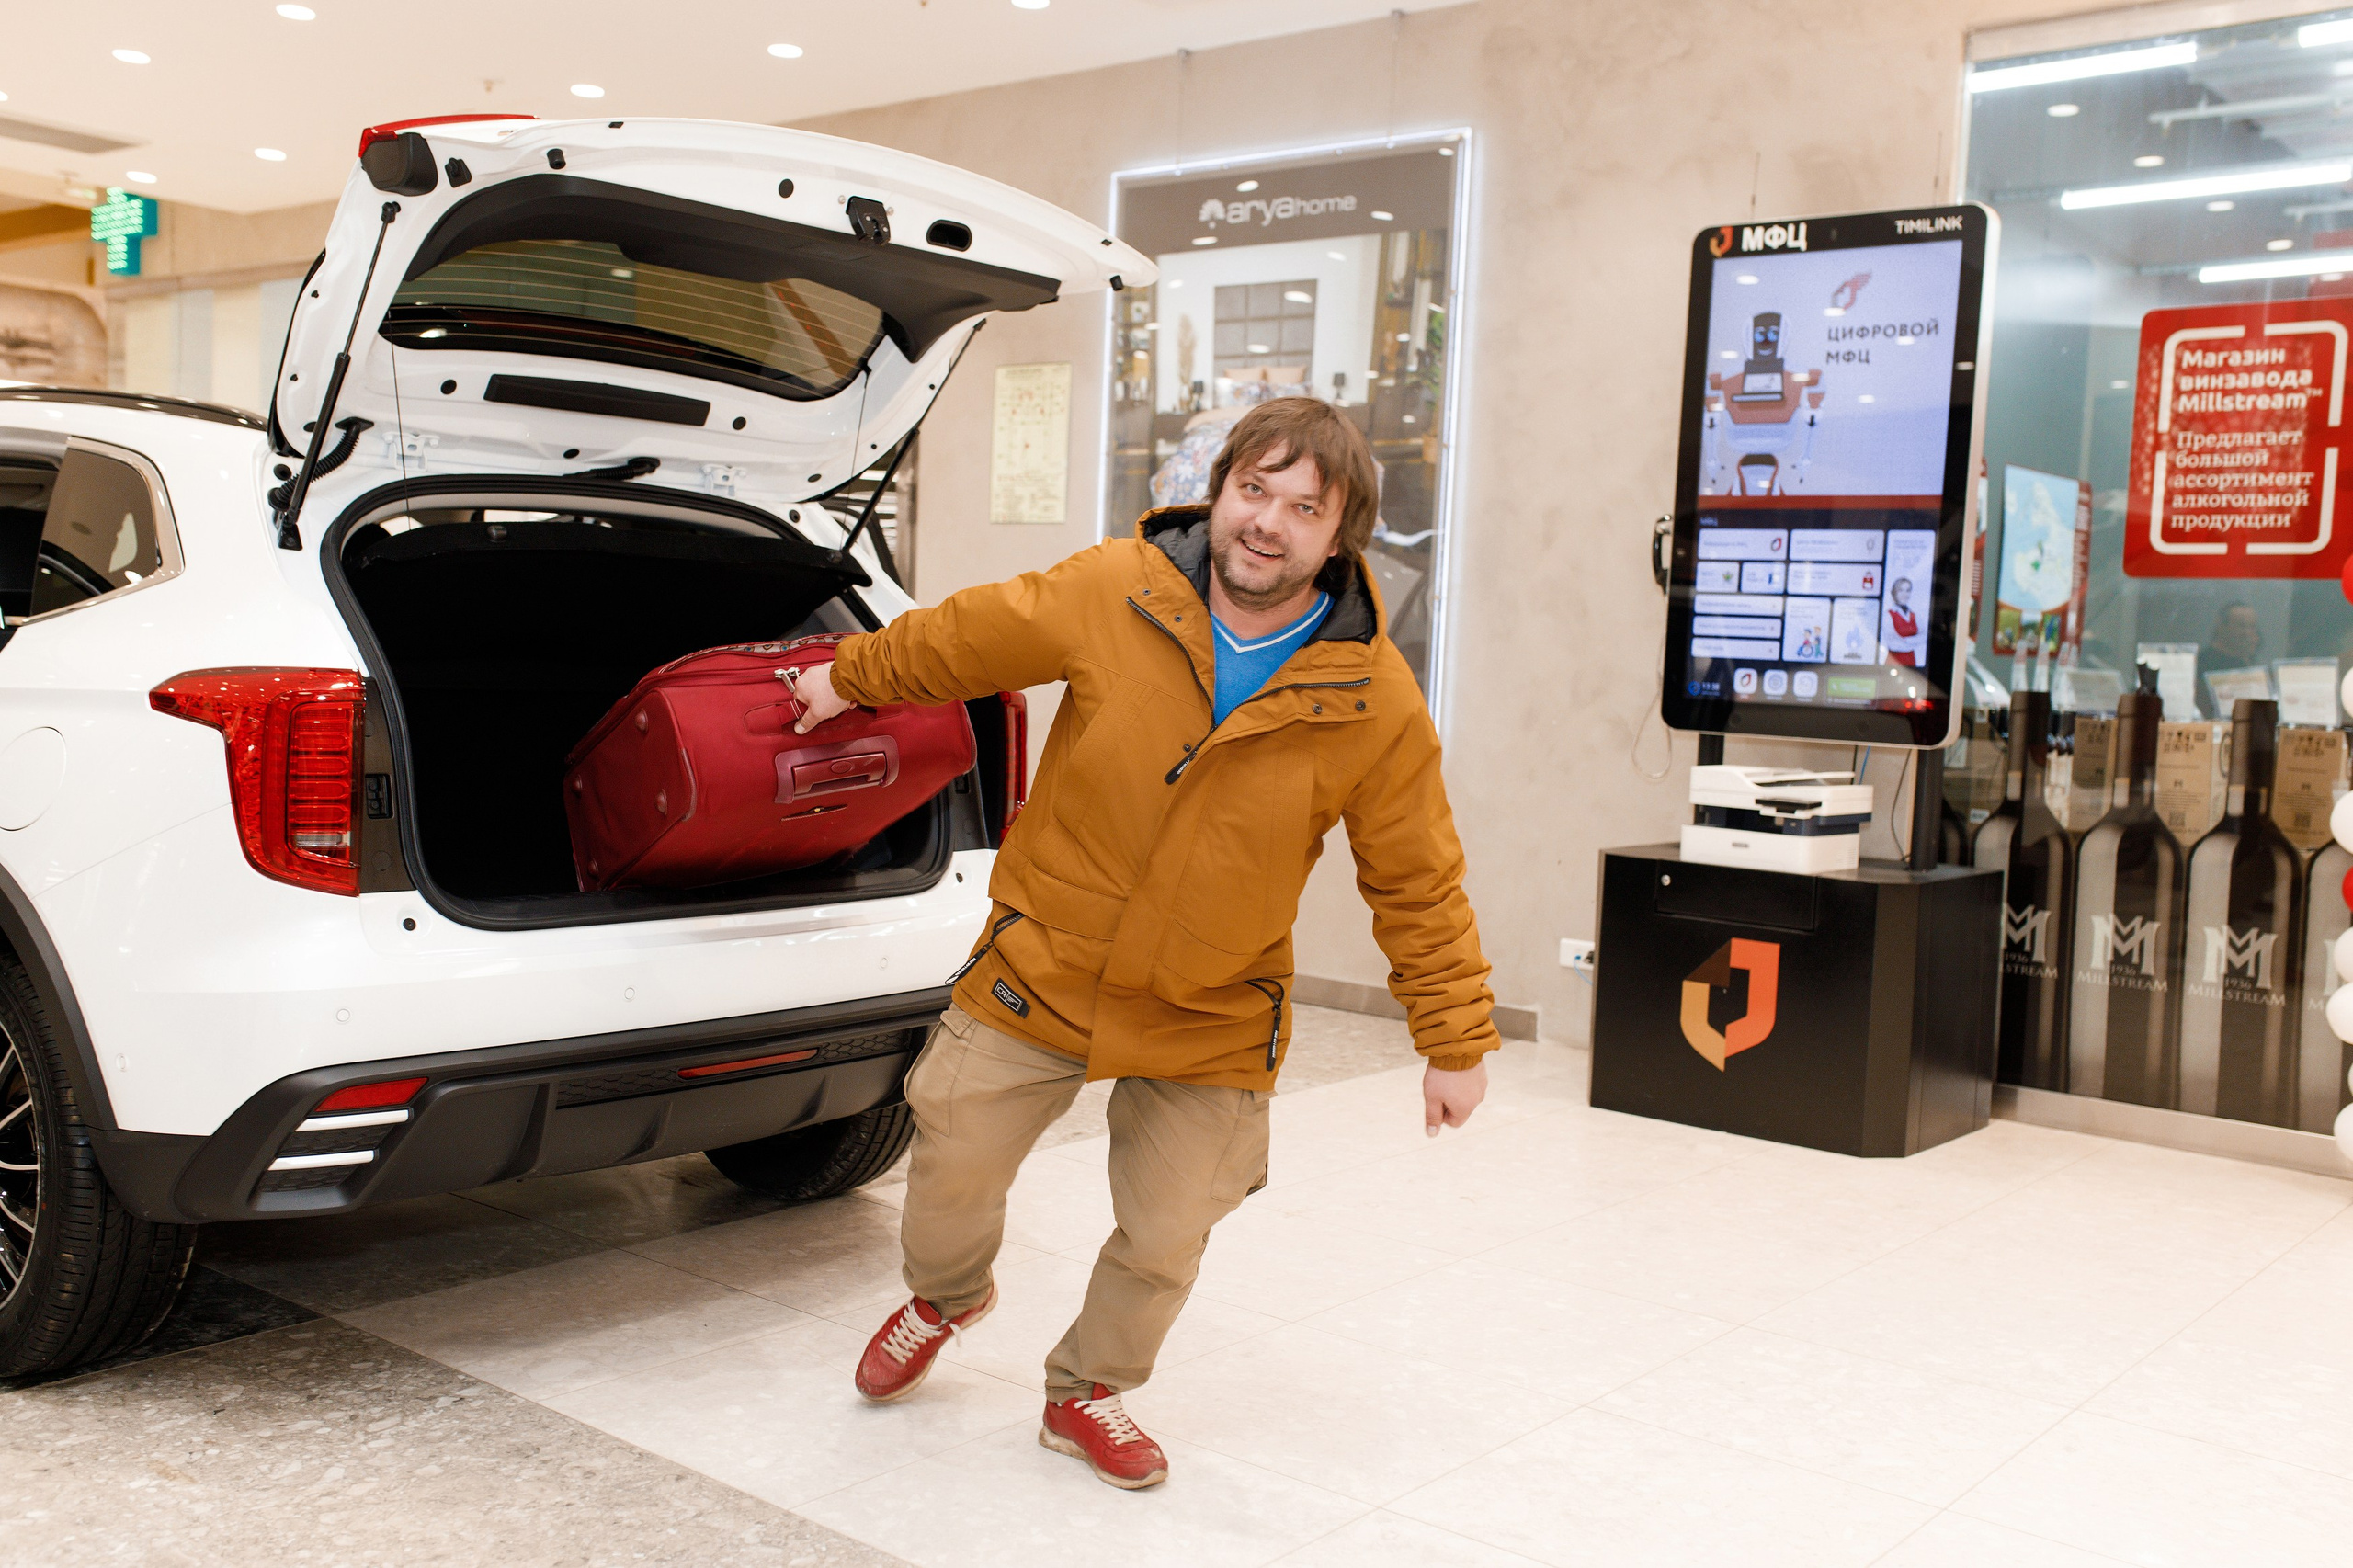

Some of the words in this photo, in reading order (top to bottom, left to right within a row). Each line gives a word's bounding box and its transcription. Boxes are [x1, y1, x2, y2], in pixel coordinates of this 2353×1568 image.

[1895, 215, 1963, 234] TIMILINK
[1742, 222, 1807, 252] МФЦ
[1827, 318, 1939, 342] ЦИФРОВОЙ
[1826, 347, 1870, 365] МФЦ
[2181, 347, 2286, 369] Магазин
[2179, 369, 2313, 392] винзавода
[2177, 429, 2303, 449] Предлагает
[2175, 449, 2269, 469] большой
[2173, 472, 2315, 491] ассортимент
[2172, 488, 2310, 508] алкогольной
[2170, 513, 2291, 533] продукции
[2005, 963, 2058, 980] STREAM
